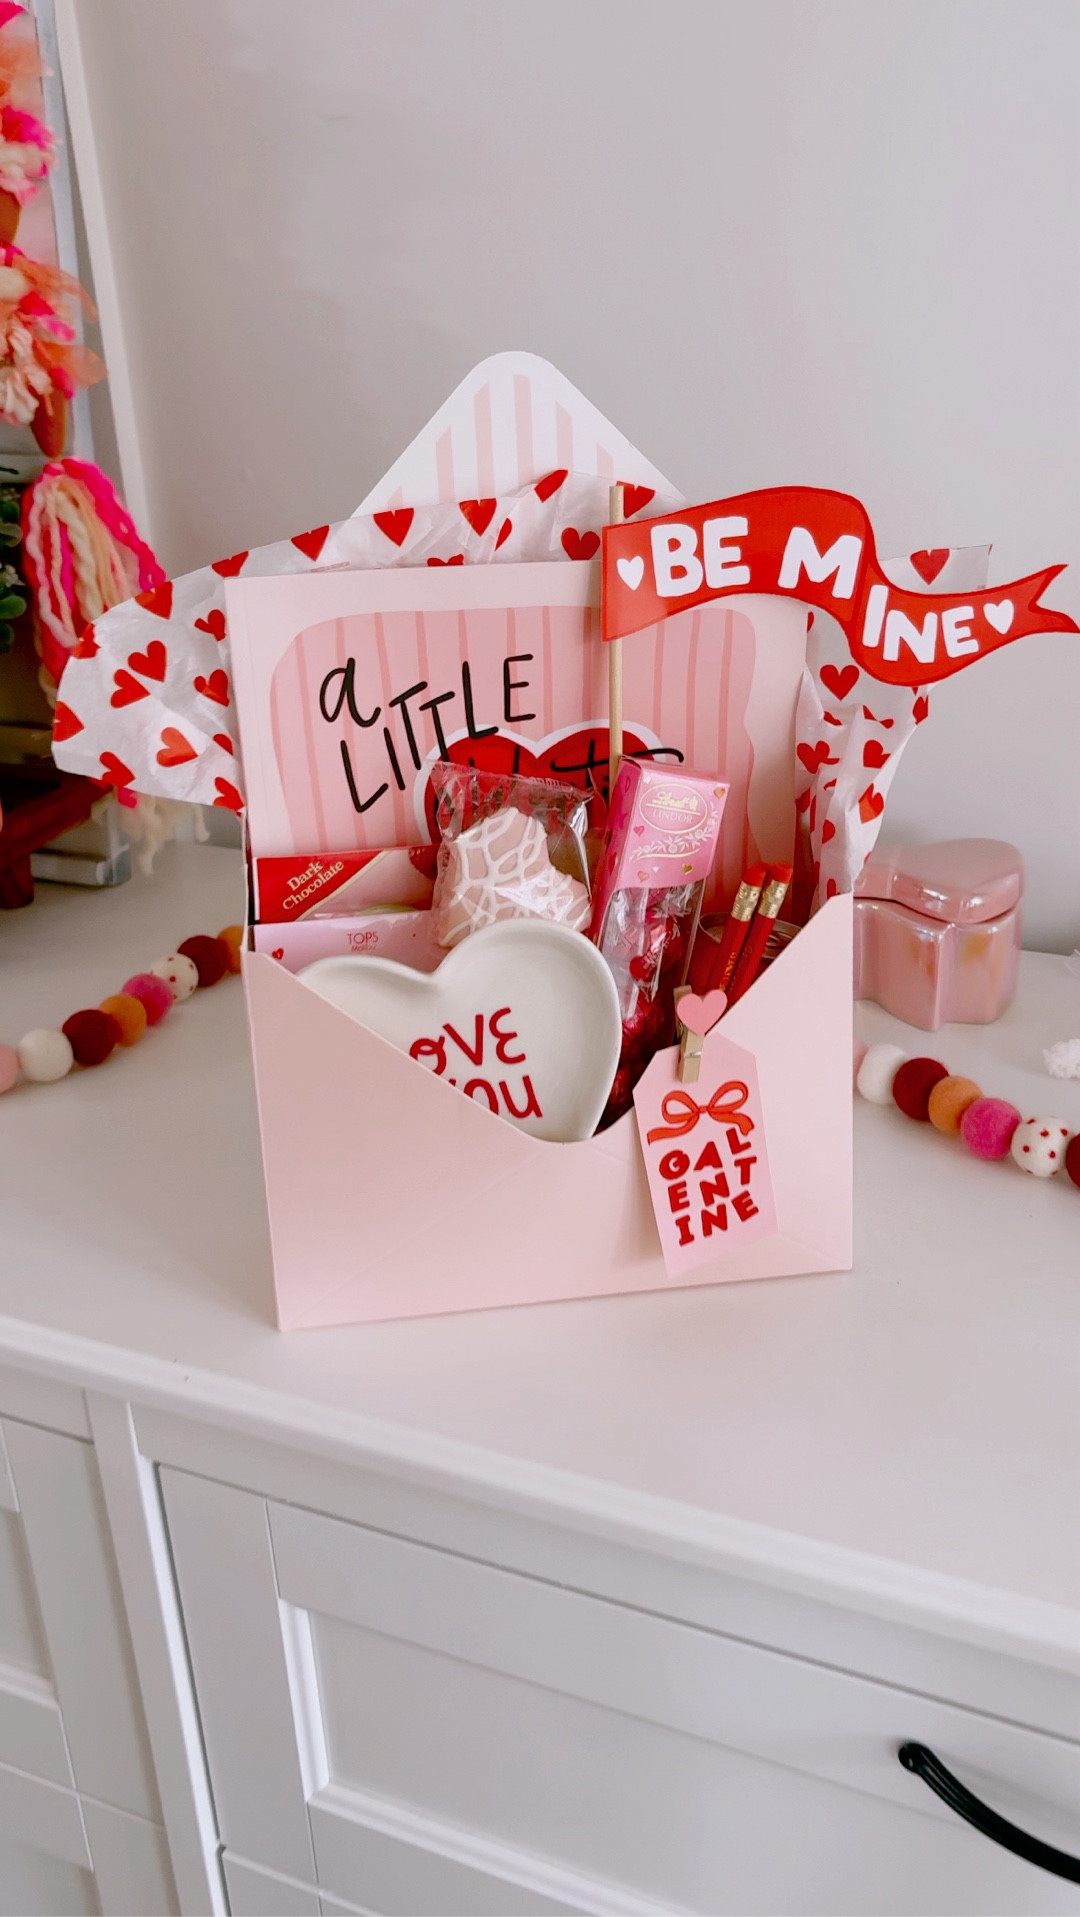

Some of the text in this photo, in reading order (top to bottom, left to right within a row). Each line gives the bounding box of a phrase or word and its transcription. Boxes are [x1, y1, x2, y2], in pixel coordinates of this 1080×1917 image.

[650, 516, 750, 597] BE
[320, 658, 382, 727] a
[340, 653, 536, 813] LITTLE
[653, 809, 693, 824] LINDOR
[282, 861, 345, 910] Chocolate
[287, 860, 323, 891] Dark
[347, 931, 379, 944] TOPS
[409, 1007, 526, 1076] OVE
[449, 1070, 543, 1119] OU
